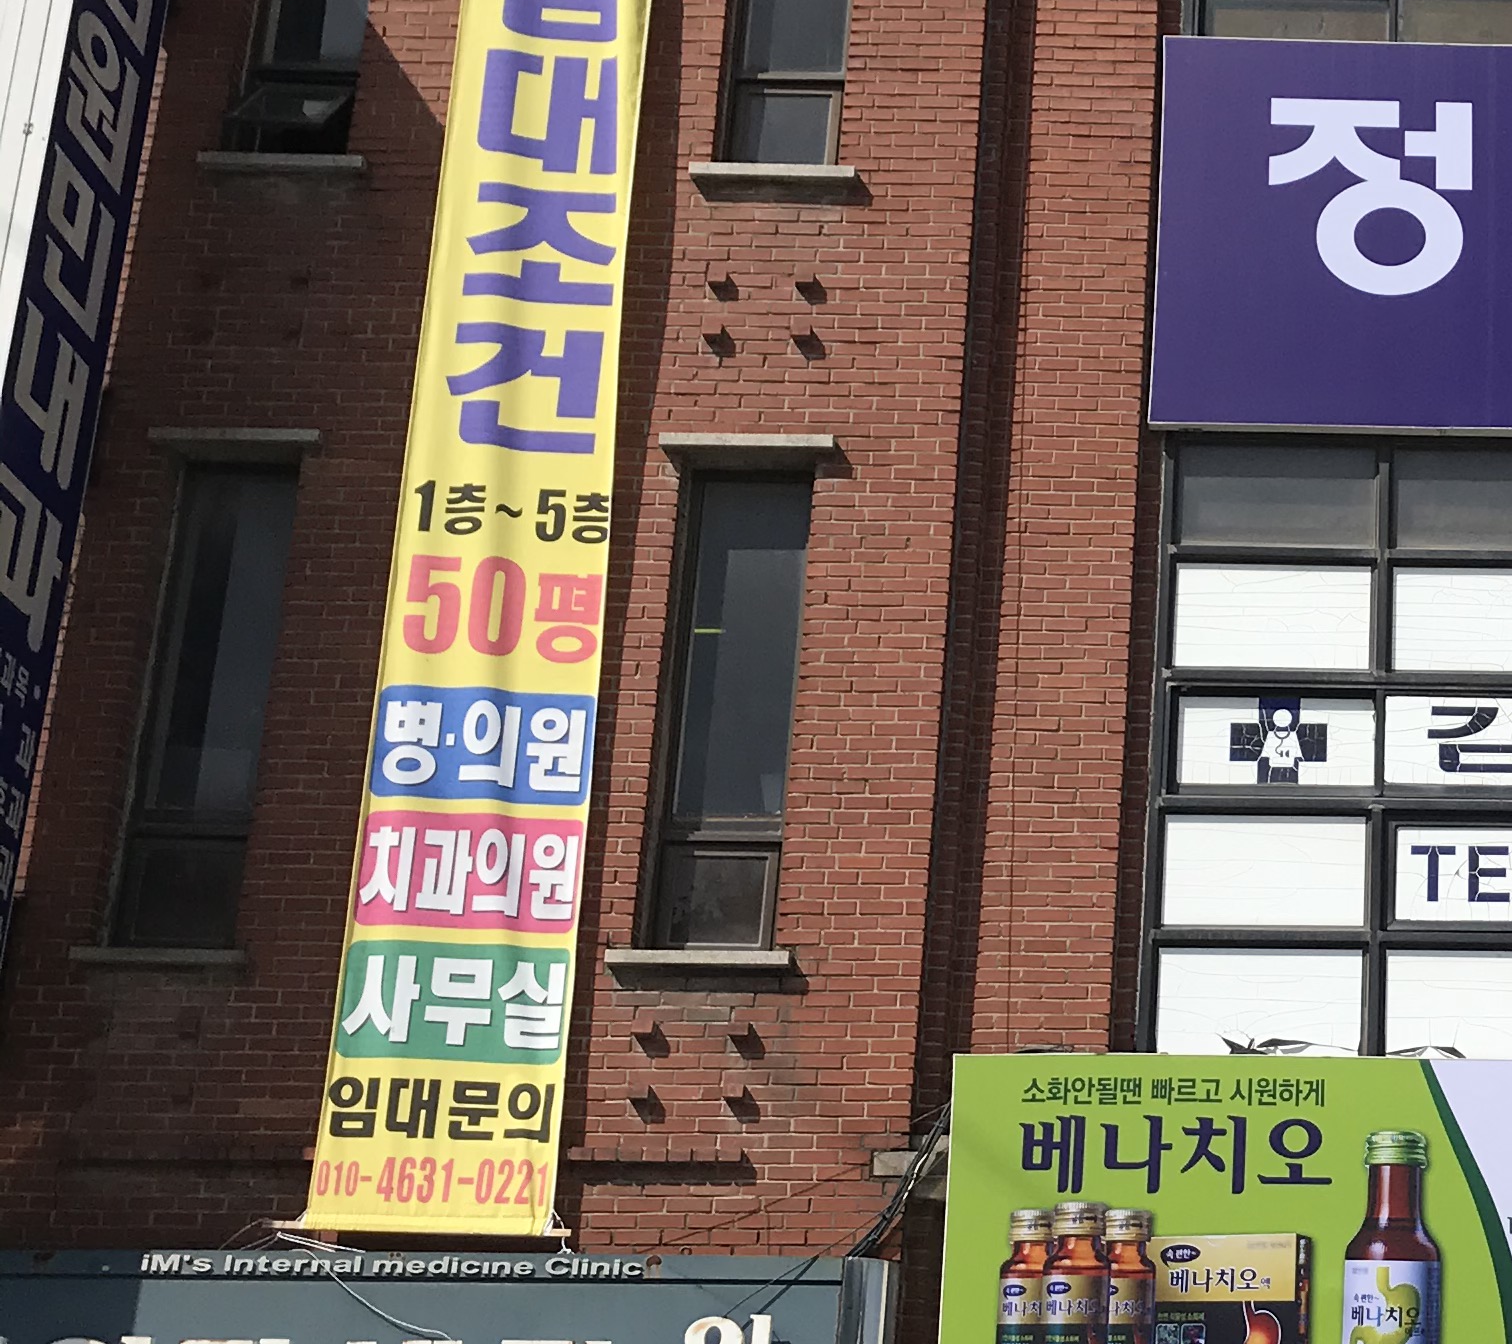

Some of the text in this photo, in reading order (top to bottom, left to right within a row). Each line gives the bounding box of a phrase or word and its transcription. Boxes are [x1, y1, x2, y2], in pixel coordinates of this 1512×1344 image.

[401, 553, 604, 664] 50평
[357, 825, 580, 920] 치과의원
[340, 952, 568, 1052] 사무실
[328, 1076, 556, 1144] 임대문의
[1150, 1077, 1223, 1106] 빠르고
[1229, 1077, 1327, 1108] 시원하게
[316, 1156, 549, 1207] 010-4631-0221
[1019, 1113, 1333, 1195] 베나치오
[543, 1256, 647, 1279] Clinic
